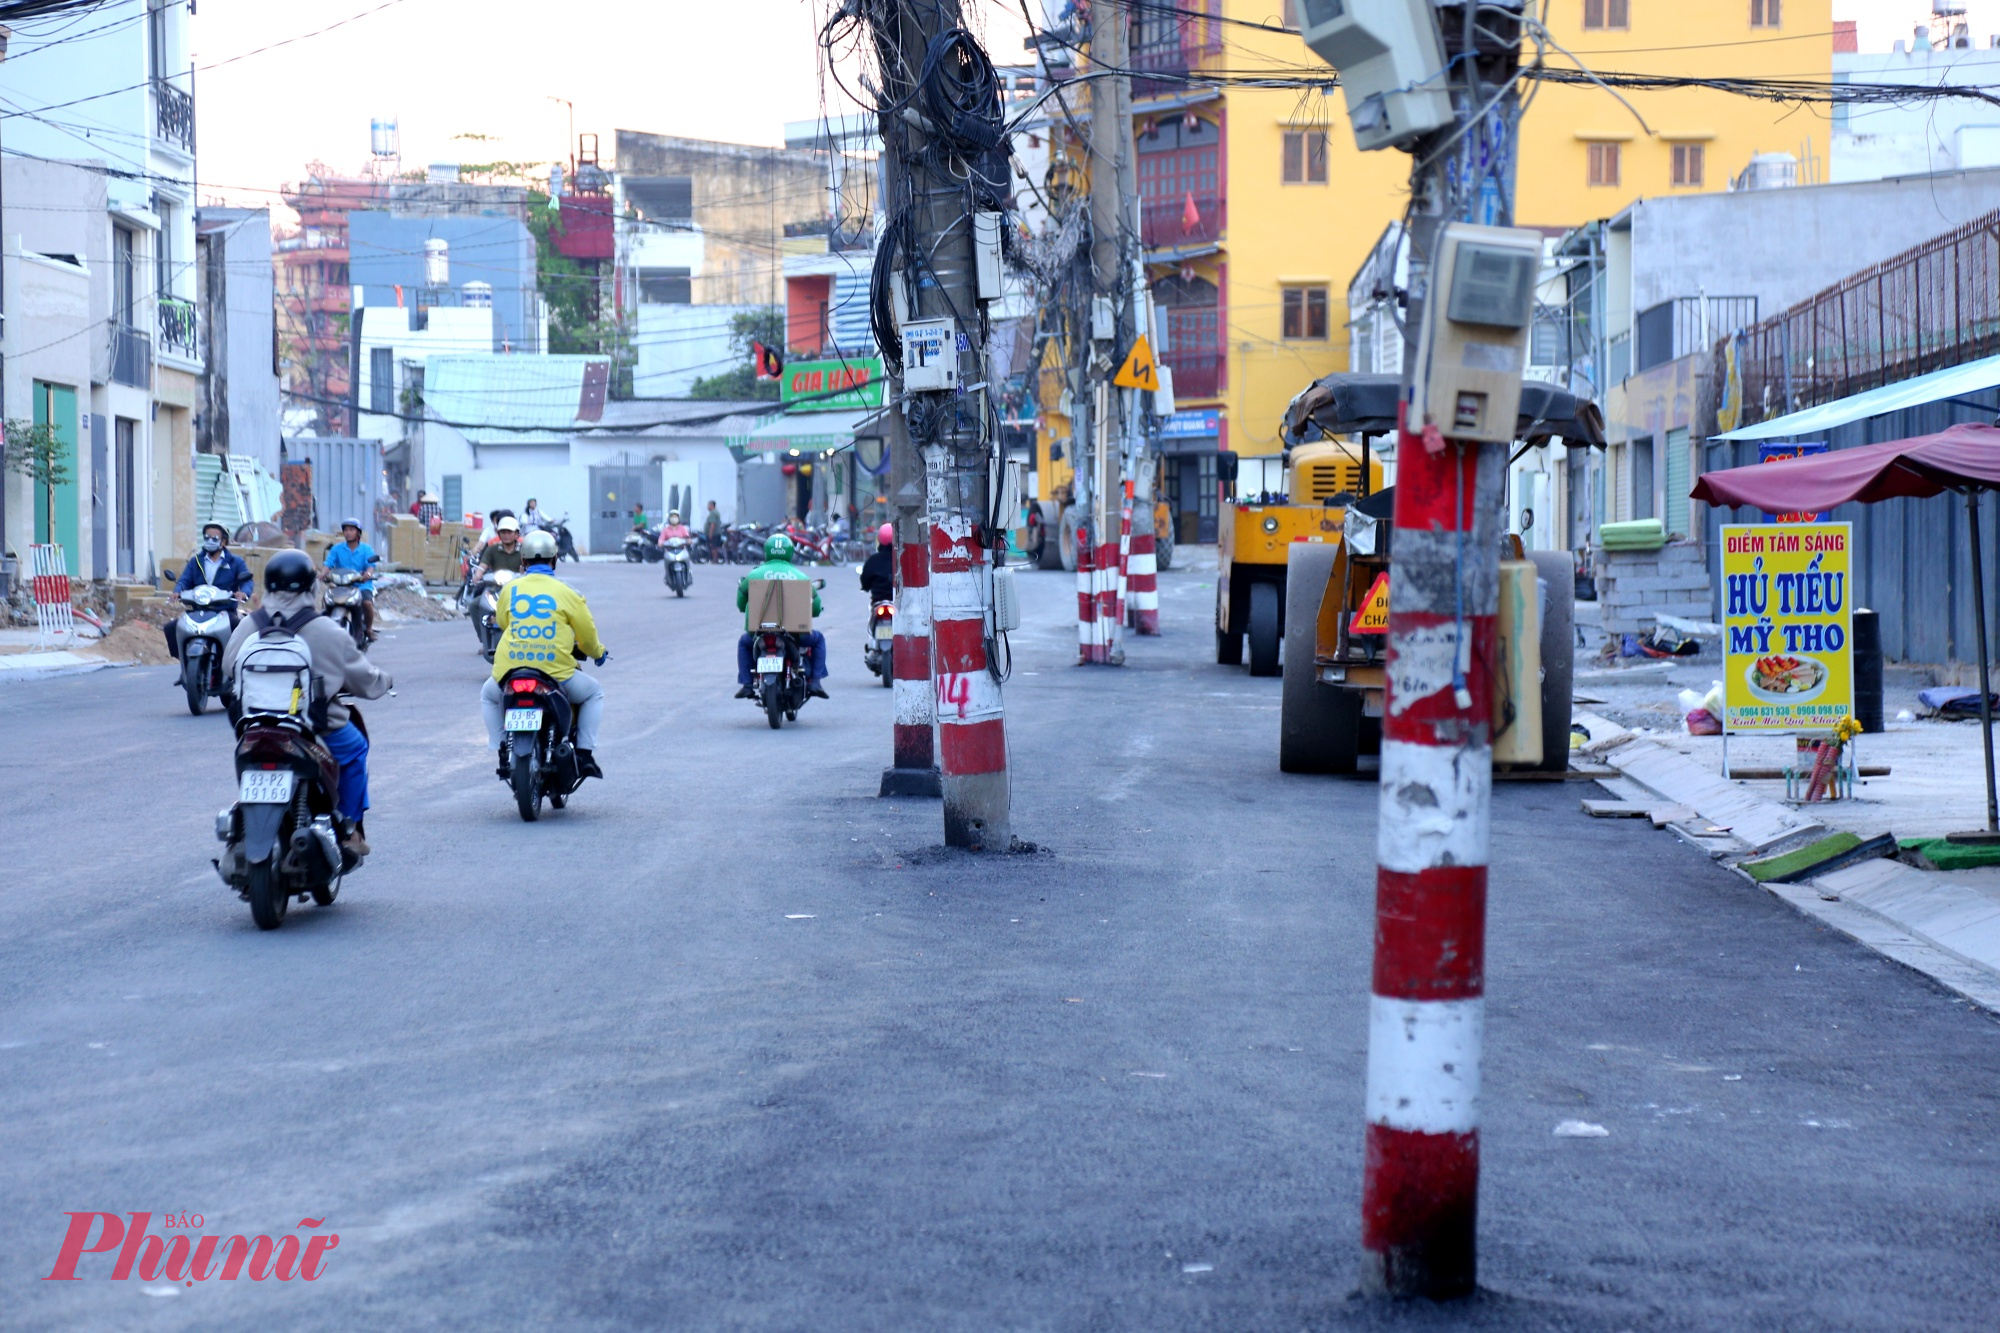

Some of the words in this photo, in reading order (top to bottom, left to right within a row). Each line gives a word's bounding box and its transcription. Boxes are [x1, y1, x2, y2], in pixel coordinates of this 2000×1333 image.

[792, 369, 823, 394] GIA
[1728, 530, 1764, 553] ĐIỂM
[1769, 532, 1800, 552] TÂM
[1805, 531, 1845, 552] SÁNG
[763, 570, 798, 580] Grab
[1727, 556, 1769, 617] HỦ
[1776, 553, 1844, 617] TIẾU
[510, 585, 557, 619] be
[511, 621, 557, 640] Food
[1729, 617, 1775, 654] MỸ
[1781, 624, 1845, 655] THO
[511, 711, 536, 720] 63-B5
[1740, 707, 1759, 717] 0904
[1761, 706, 1774, 716] 831
[1776, 706, 1790, 716] 930
[1797, 706, 1816, 716] 0908
[1835, 704, 1848, 715] 657
[249, 773, 284, 786] 93-P2
[244, 787, 288, 801] 191.69
